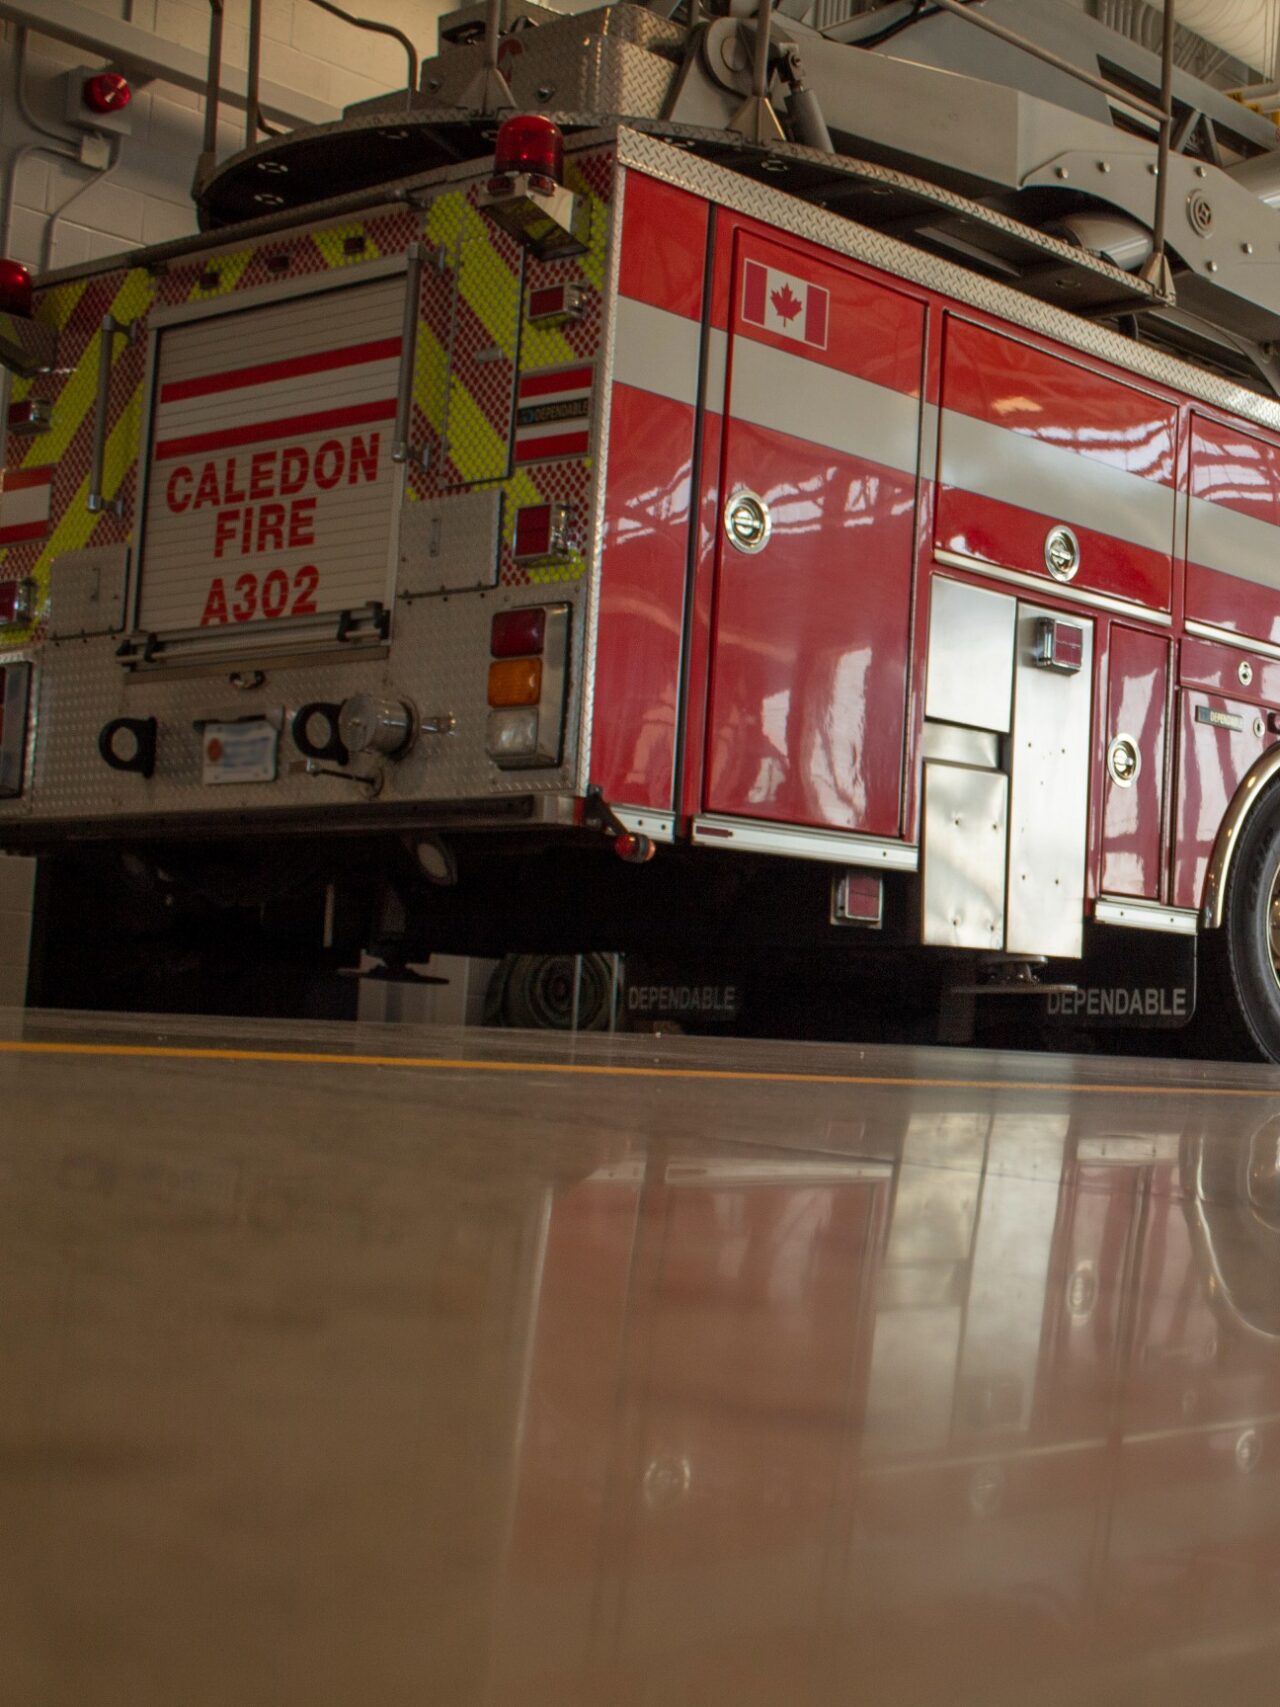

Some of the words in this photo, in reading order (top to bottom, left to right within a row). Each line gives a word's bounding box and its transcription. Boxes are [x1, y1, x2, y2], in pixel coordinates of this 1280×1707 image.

[165, 432, 381, 514] CALEDON
[213, 497, 317, 559] FIRE
[200, 565, 320, 626] A302
[628, 986, 736, 1011] DEPENDABLE
[1047, 987, 1187, 1016] DEPENDABLE
